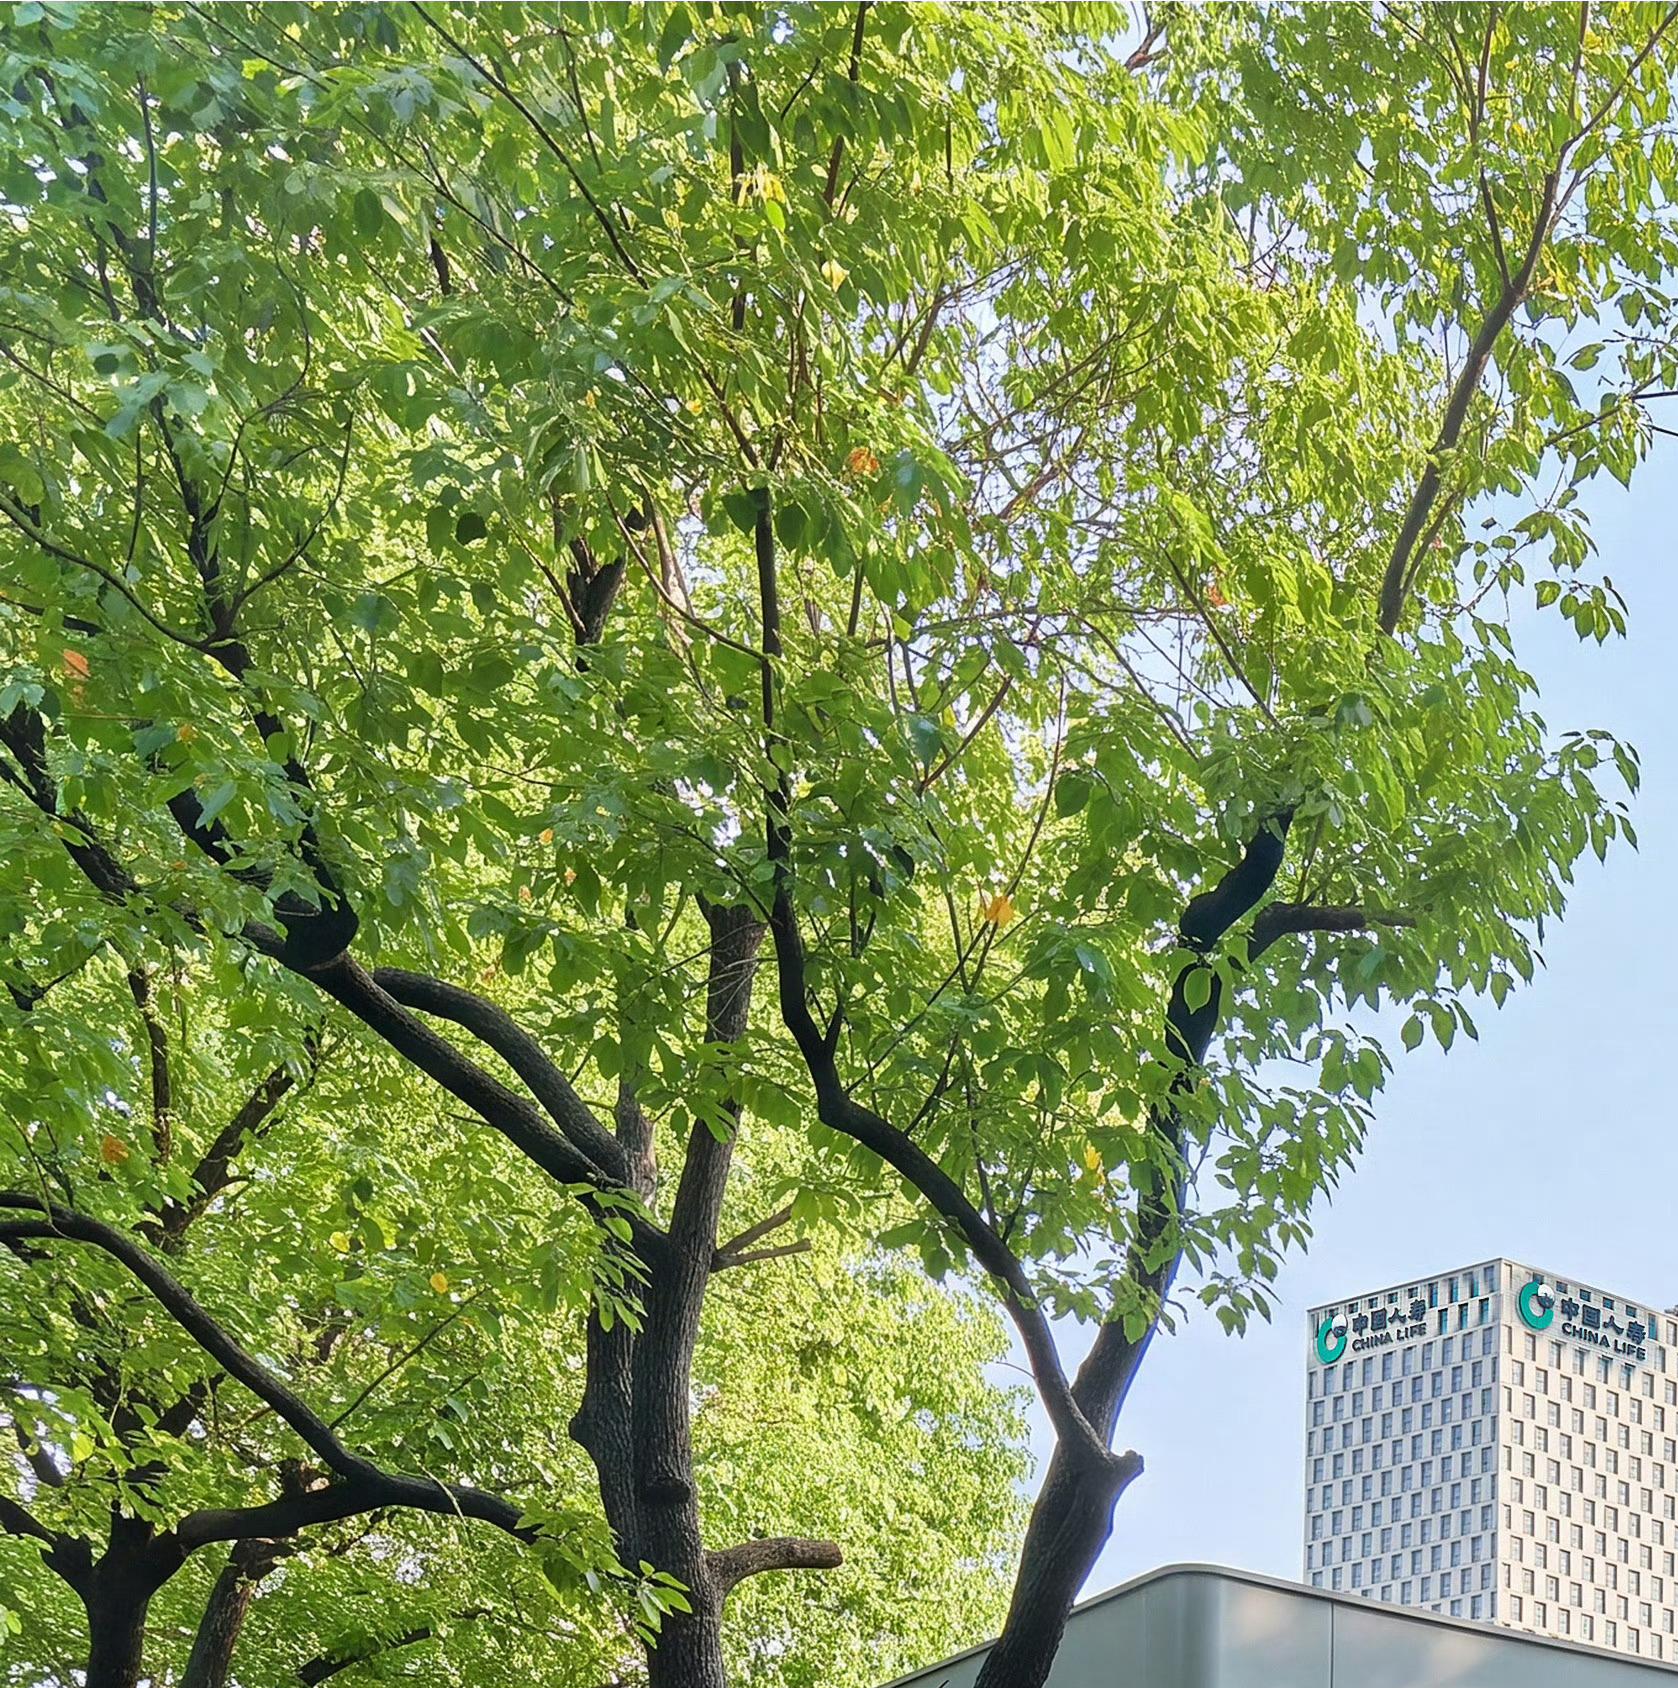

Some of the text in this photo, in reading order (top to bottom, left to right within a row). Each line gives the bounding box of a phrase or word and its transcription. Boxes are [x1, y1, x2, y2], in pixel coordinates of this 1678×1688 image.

[1352, 1299, 1426, 1337] 中国人寿
[1561, 1297, 1646, 1345] 中国人寿
[1352, 1323, 1427, 1352] CHINA LIFE
[1562, 1322, 1646, 1361] CHINA LIFE
